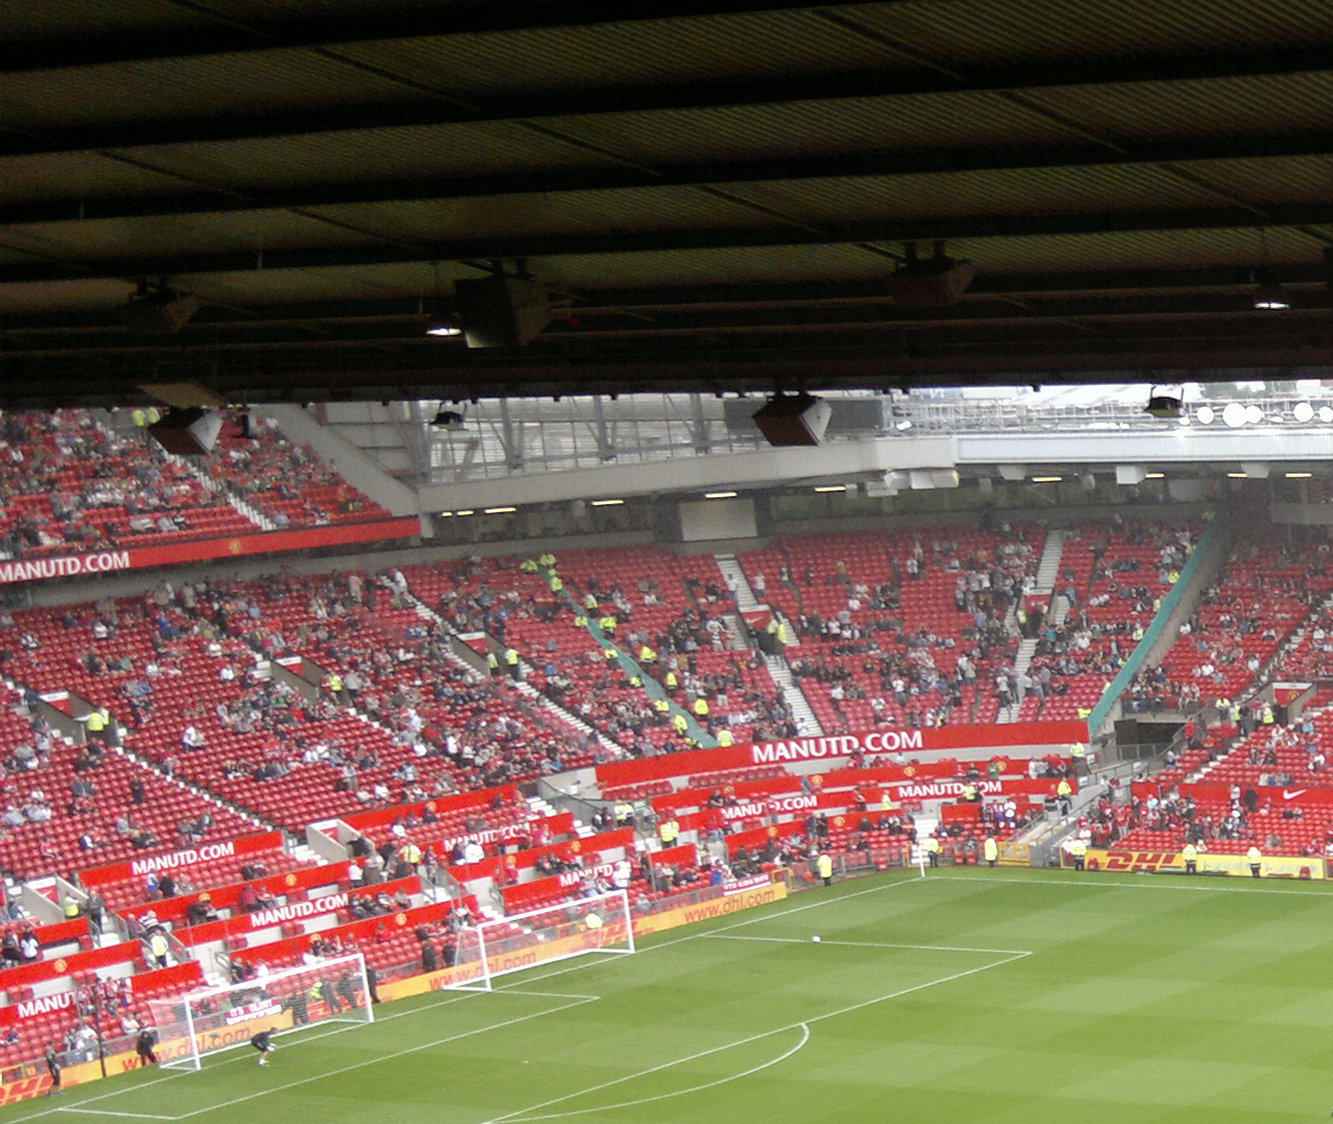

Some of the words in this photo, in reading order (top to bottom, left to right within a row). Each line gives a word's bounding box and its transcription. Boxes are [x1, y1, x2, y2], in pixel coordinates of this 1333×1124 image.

[0, 551, 131, 582] MANUTD.COM
[752, 731, 924, 763] MANUTD.COM
[131, 841, 235, 876] MANUTD.COM
[1105, 852, 1183, 871] DHL
[250, 893, 350, 928] MANUTD.COM
[684, 889, 775, 923] www.dhl.com
